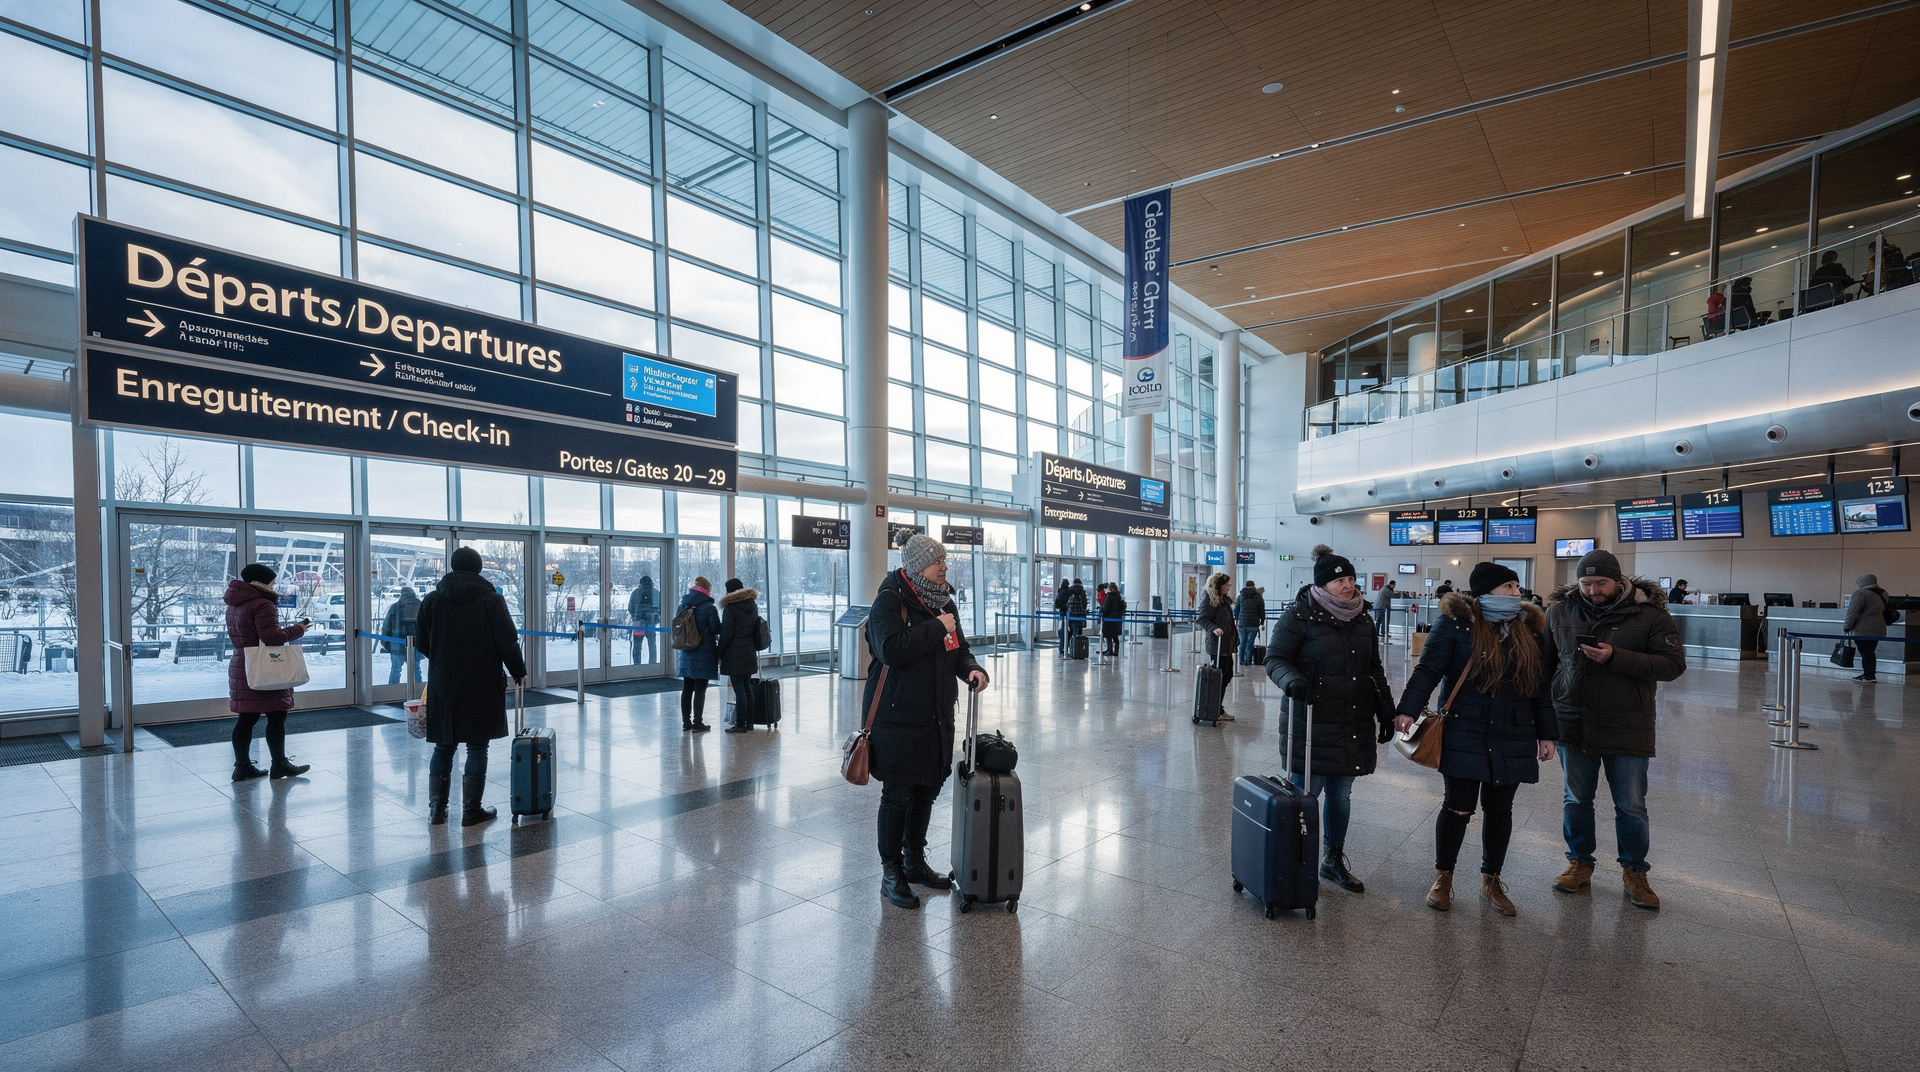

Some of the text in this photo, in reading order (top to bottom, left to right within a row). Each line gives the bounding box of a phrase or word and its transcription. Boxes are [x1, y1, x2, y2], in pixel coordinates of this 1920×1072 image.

[116, 368, 382, 430] Enreguiterment
[403, 411, 510, 447] Check-in
[559, 450, 612, 473] Portes
[624, 458, 669, 480] Gates
